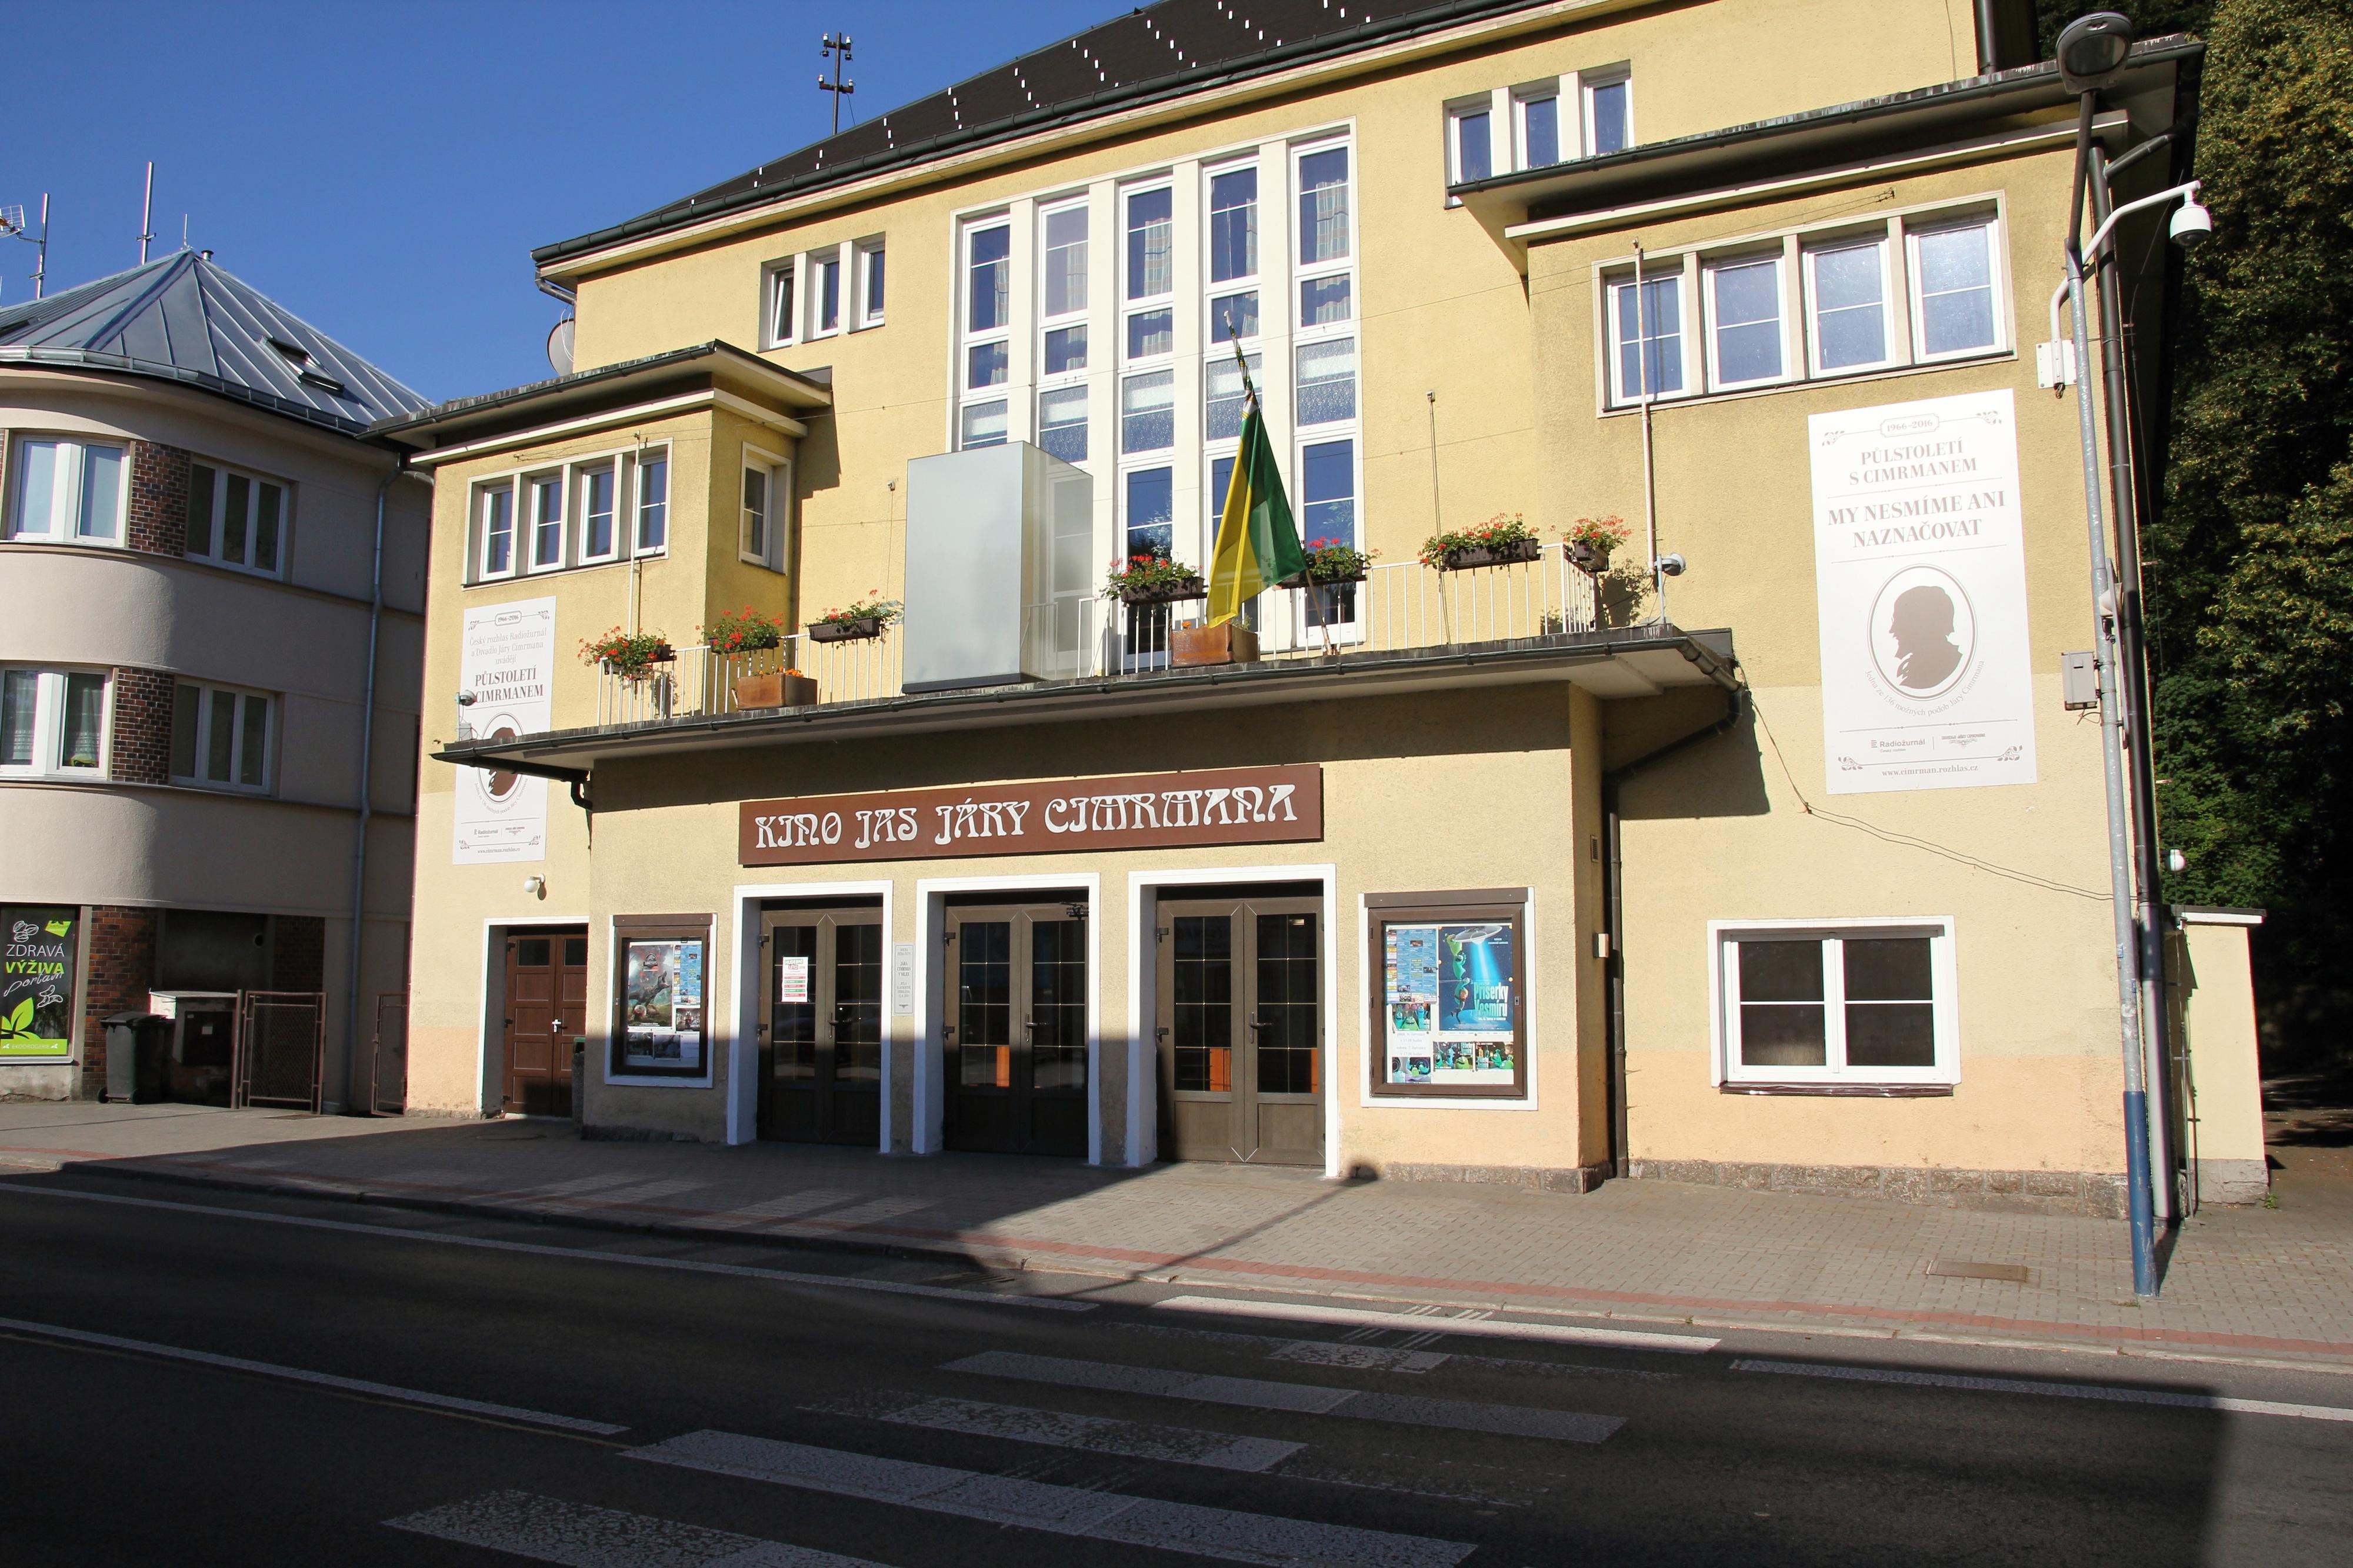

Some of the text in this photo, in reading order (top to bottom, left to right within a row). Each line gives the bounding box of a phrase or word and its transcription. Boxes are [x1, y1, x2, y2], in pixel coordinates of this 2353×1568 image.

[1860, 437, 1964, 465] PŮLSTOLETÍ
[1849, 458, 1977, 486] S CIMRMANEM
[1828, 491, 2005, 525] MY NESMÍME ANI
[1852, 519, 1982, 548] NAZNAČOVAT
[475, 664, 536, 686] PŮLSTOLETÍ
[476, 684, 544, 703] CIMRMANEM
[1879, 739, 1925, 748] Radiožurnál
[1881, 765, 1978, 777] www.cimrman.rozhlas.cz
[755, 783, 1298, 849] KINO JAS JÁRY CIMRMANA
[6, 943, 65, 957] ZDRAVÁ
[5, 959, 64, 974] VÝŽIVA
